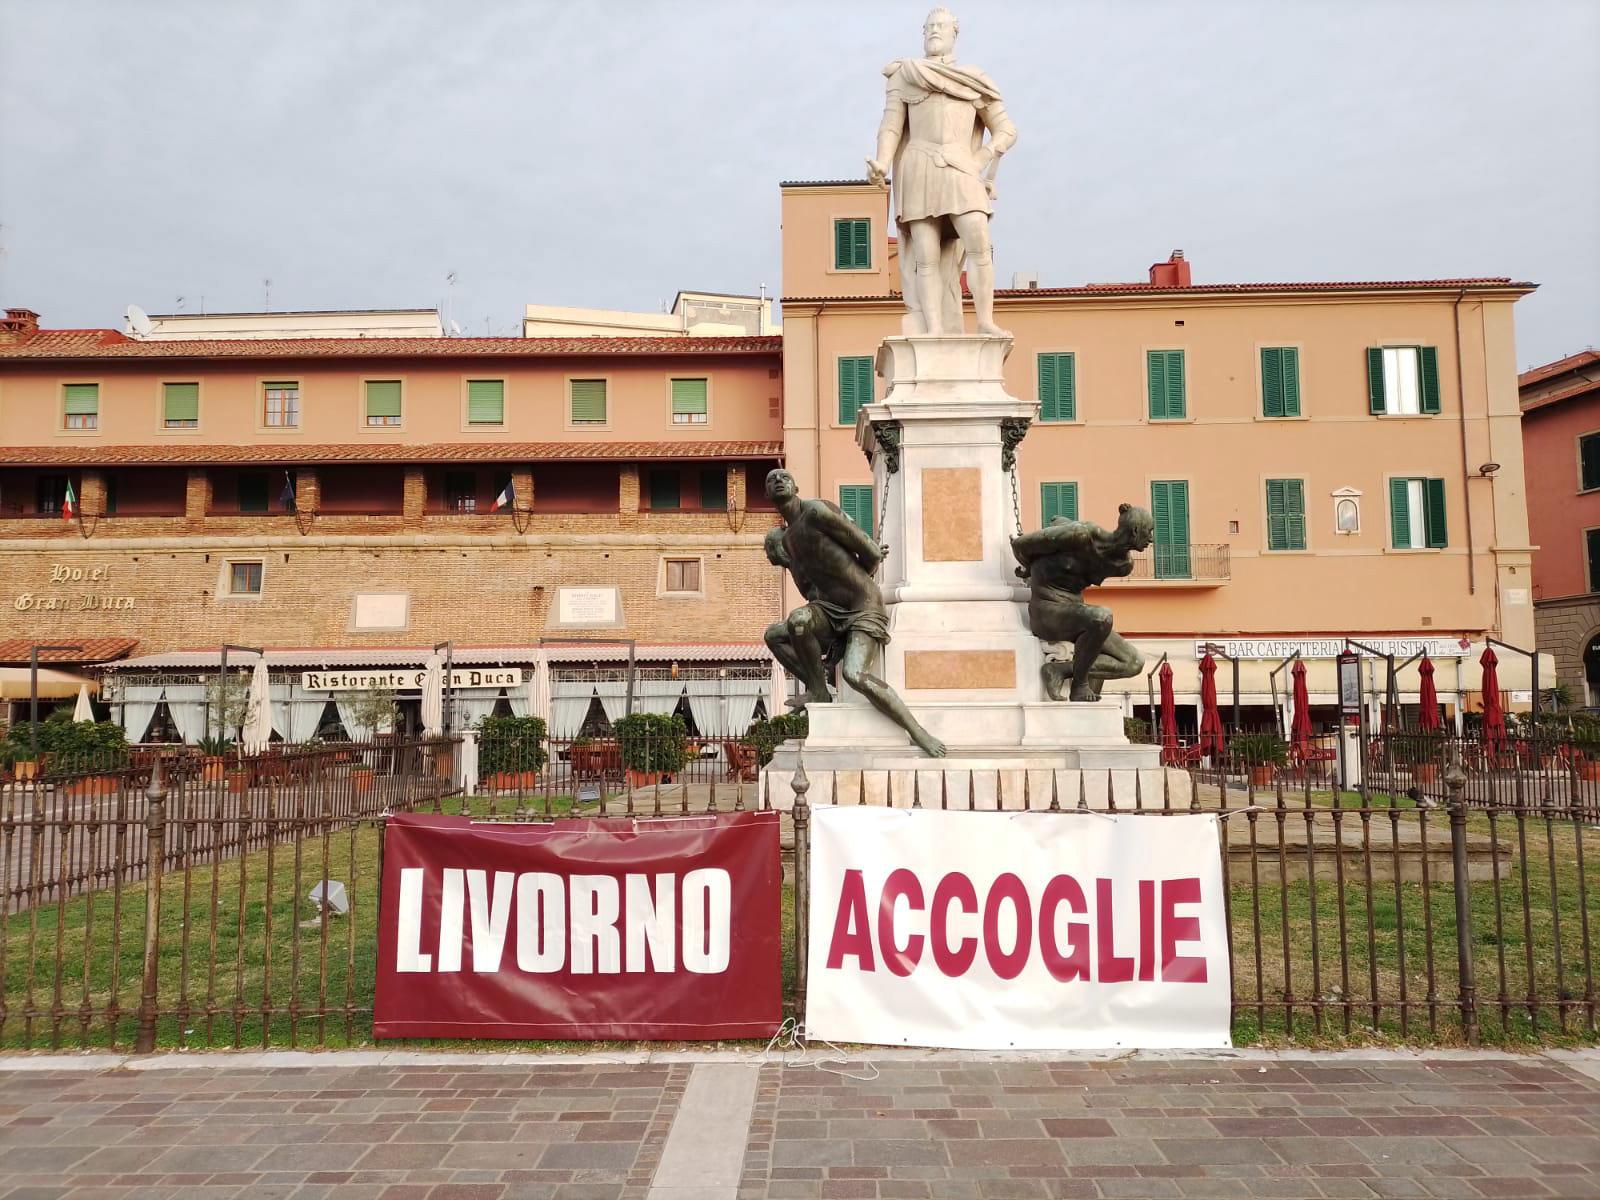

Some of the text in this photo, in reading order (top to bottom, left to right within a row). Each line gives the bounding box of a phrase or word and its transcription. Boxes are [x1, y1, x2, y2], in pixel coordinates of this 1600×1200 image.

[50, 564, 110, 583] Hotel
[14, 593, 137, 611] Gran Duca
[1228, 642, 1253, 656] BAR
[1257, 641, 1339, 656] CAFFETTERIA
[1389, 640, 1438, 655] BISTROT
[307, 673, 404, 689] Ristorante
[470, 671, 514, 686] Duca
[397, 867, 731, 974] LIVORNO
[826, 868, 1208, 983] ACCOGLIE
